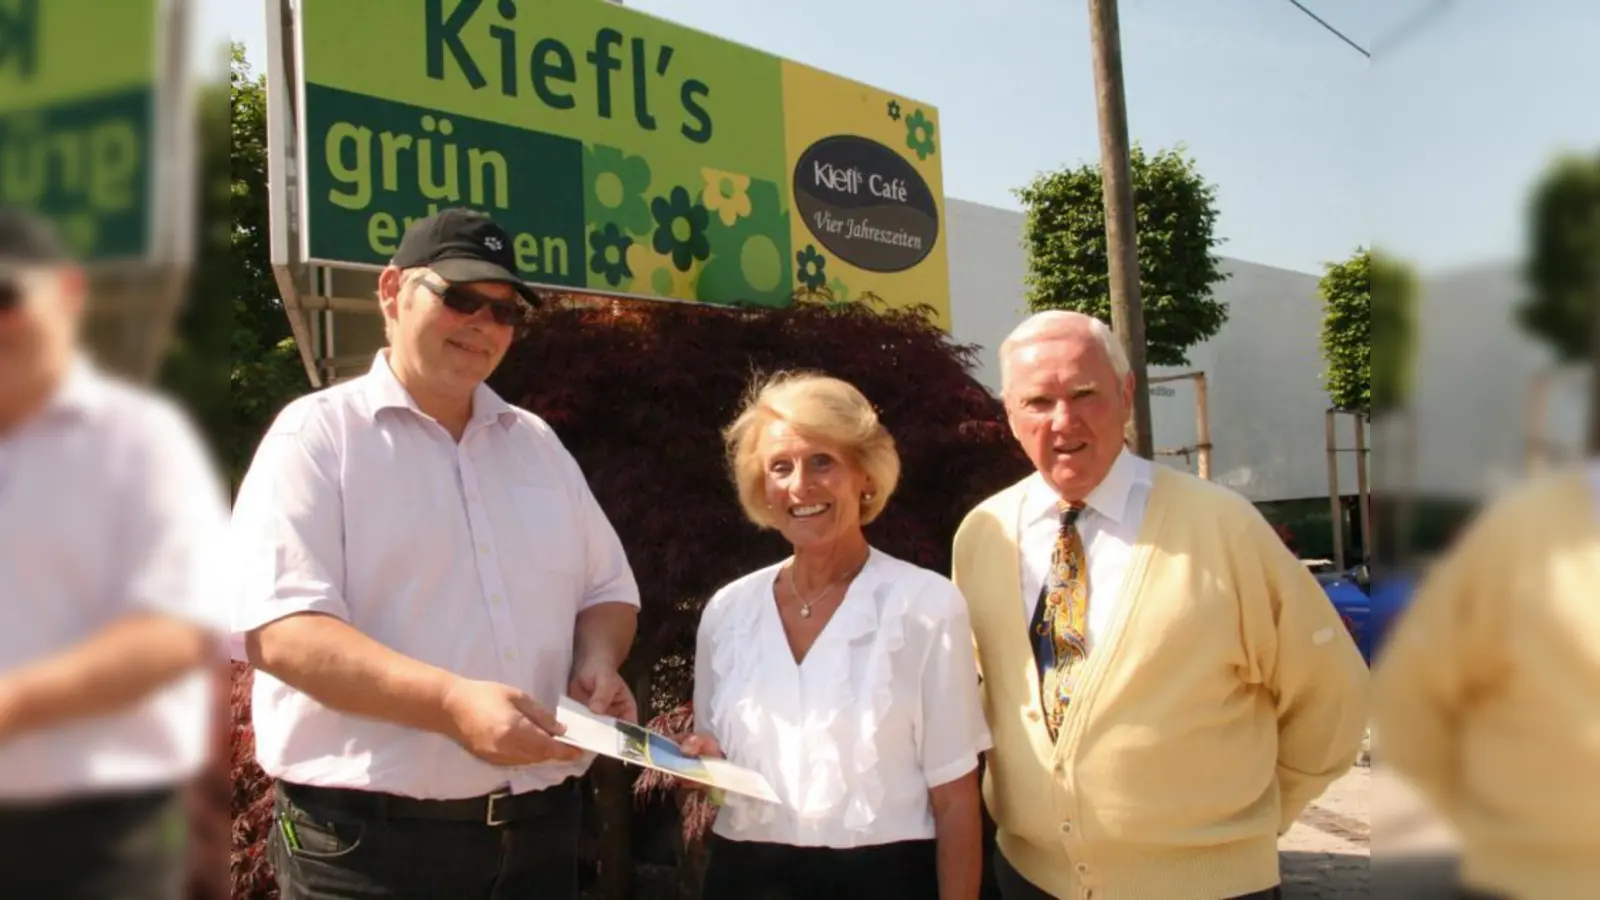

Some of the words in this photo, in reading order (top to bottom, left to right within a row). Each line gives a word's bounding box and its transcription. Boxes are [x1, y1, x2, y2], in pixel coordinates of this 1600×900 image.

[425, 0, 713, 144] Kiefl's
[325, 115, 508, 210] grün
[868, 174, 908, 201] Café
[813, 211, 844, 233] Vier
[844, 218, 922, 250] Jahreszeiten
